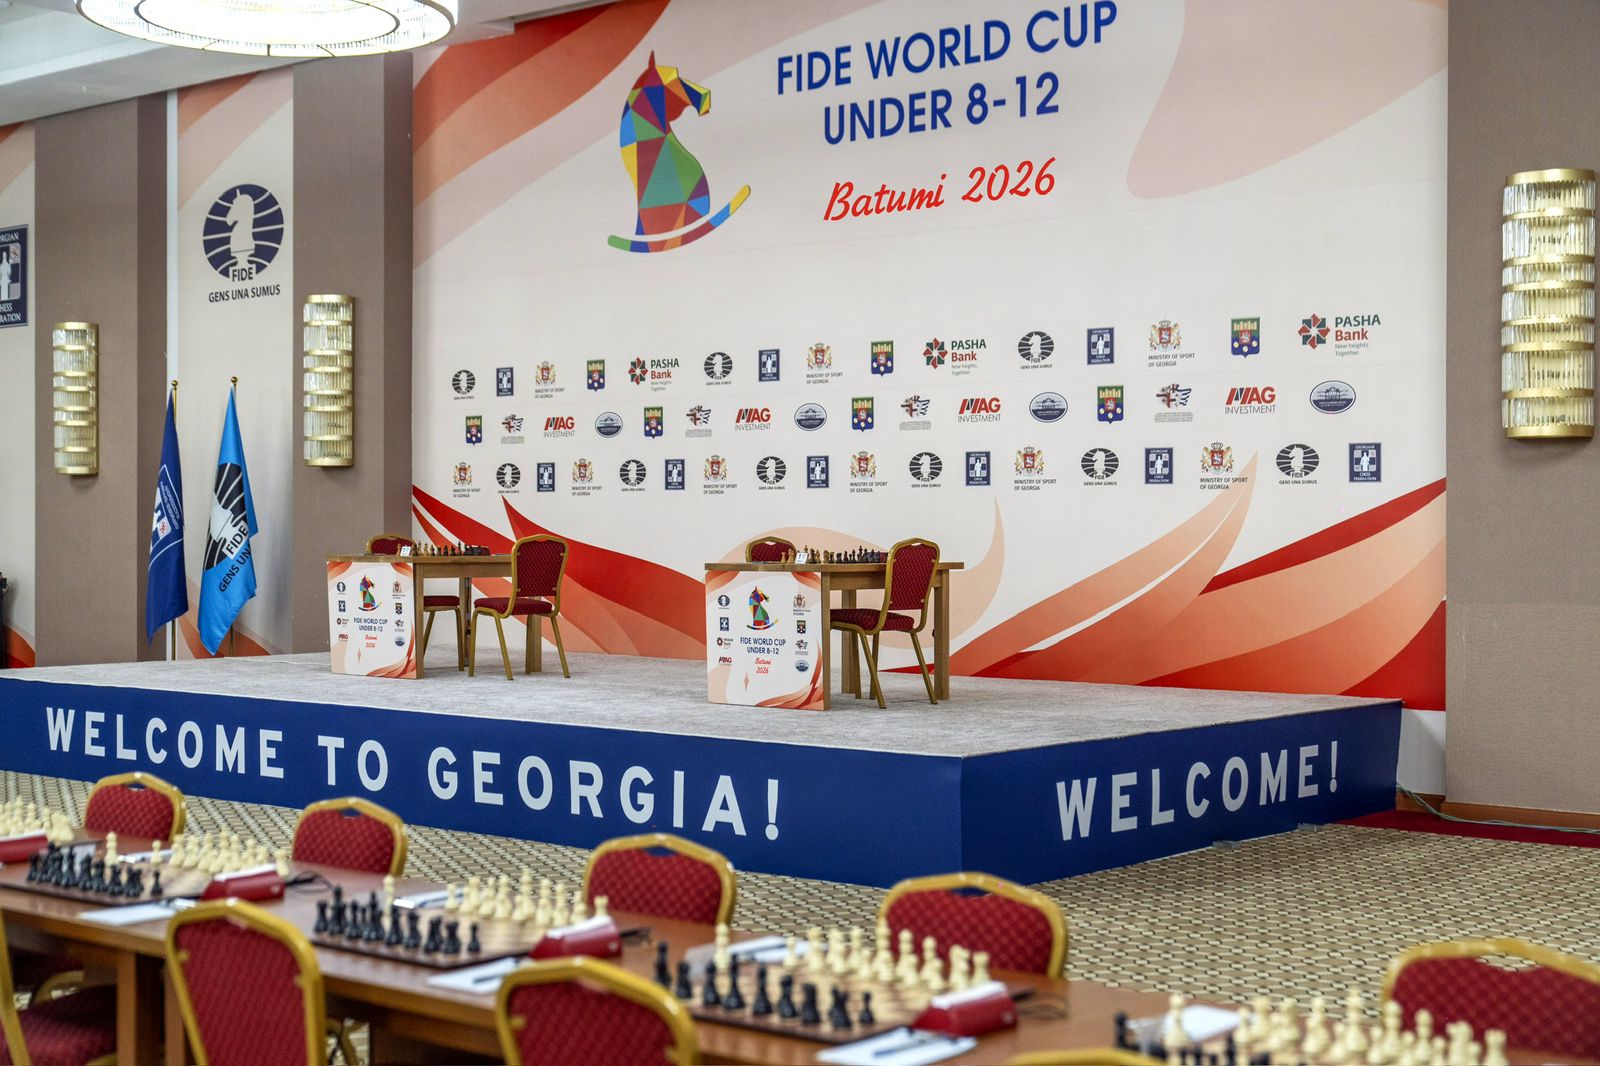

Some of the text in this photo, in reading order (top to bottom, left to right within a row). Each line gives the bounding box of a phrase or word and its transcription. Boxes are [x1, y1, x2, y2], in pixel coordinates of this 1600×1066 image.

[778, 0, 1117, 95] FIDE WORLD CUP
[824, 72, 1059, 145] UNDER 8-12
[823, 156, 1056, 221] Batumi 2026
[0, 231, 19, 242] RGIAN
[231, 267, 254, 282] FIDE
[208, 284, 281, 303] GENS UNA SUMUS
[1335, 314, 1381, 328] PASHA
[1335, 328, 1369, 342] Bank
[951, 339, 987, 350] PASHA
[650, 358, 680, 369] PASHA
[951, 351, 977, 362] Bank
[650, 369, 672, 379] Bank
[1225, 405, 1276, 414] INVESTMENT
[958, 414, 1001, 423] INVESTMENT
[735, 423, 771, 431] INVESTMENT
[225, 524, 248, 555] FIDE
[218, 542, 252, 592] GENS UN
[753, 637, 773, 646] WORLD
[774, 639, 786, 647] CUP
[747, 646, 765, 654] UNDER
[45, 705, 780, 841] WELCOME TO GEORGIA!
[1056, 740, 1338, 841] WELCOME!
